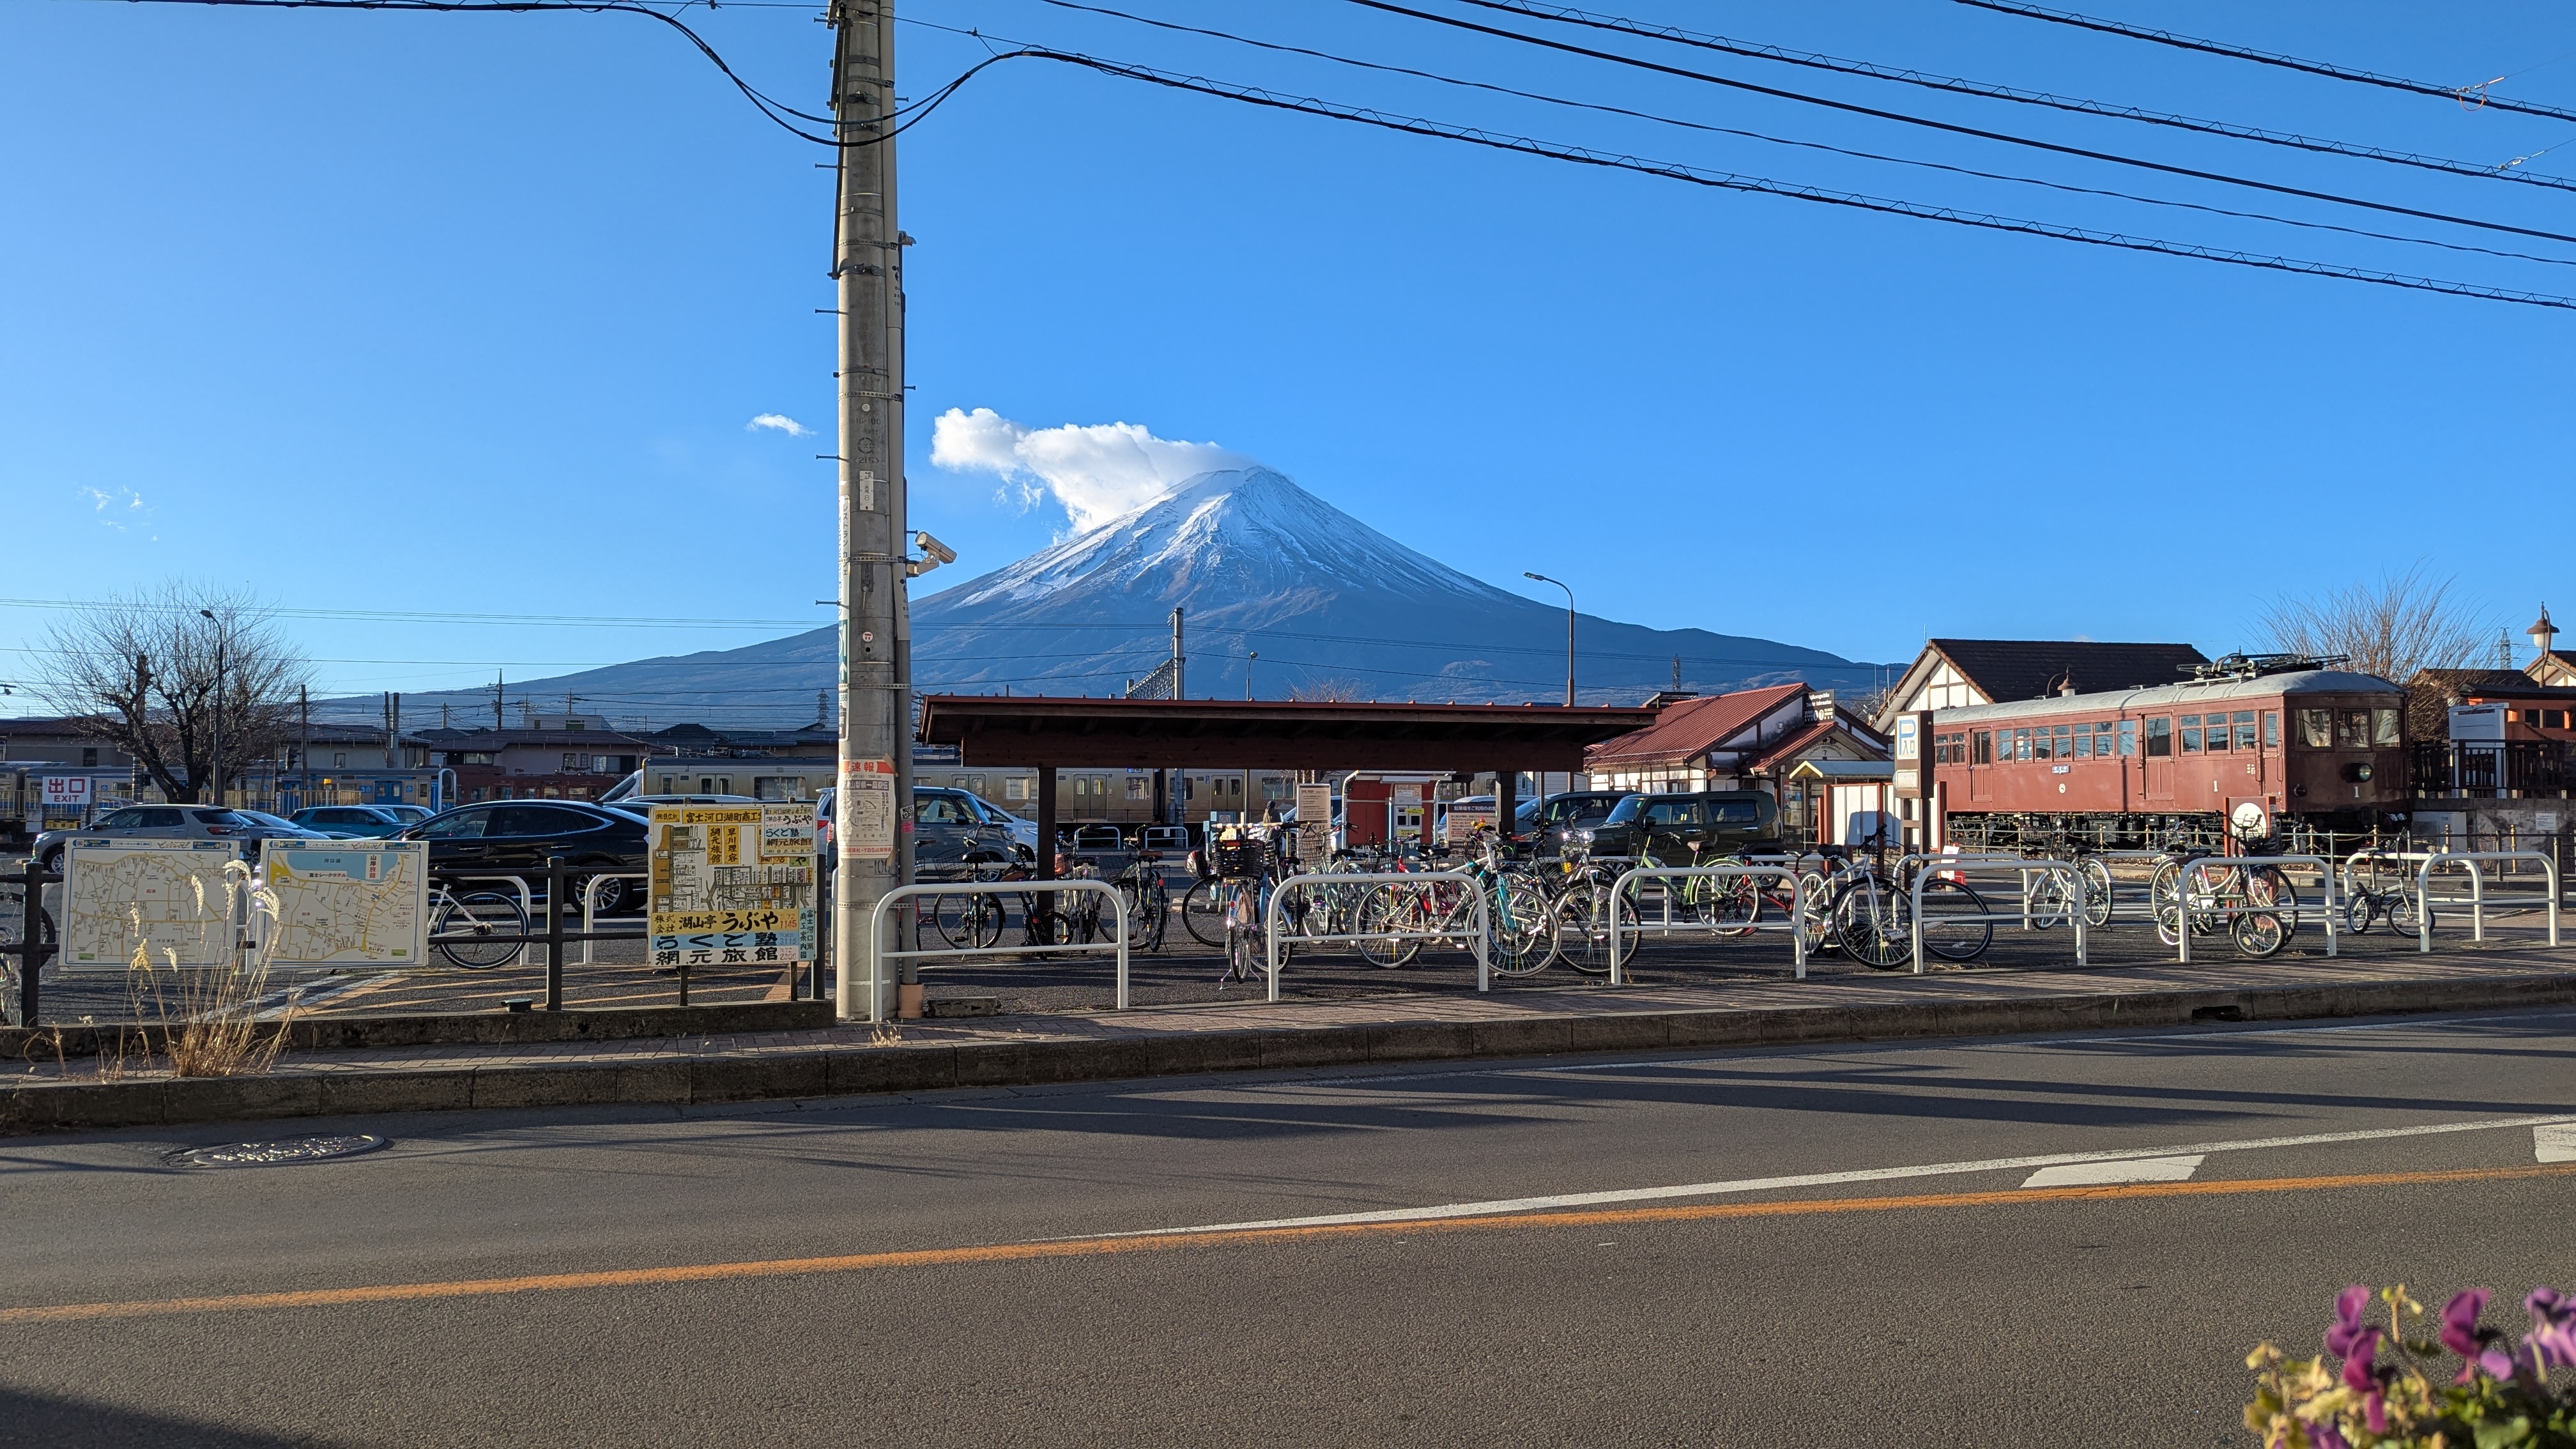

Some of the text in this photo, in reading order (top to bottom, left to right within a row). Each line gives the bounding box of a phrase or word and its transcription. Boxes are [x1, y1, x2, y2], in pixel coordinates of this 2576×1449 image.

[1899, 719, 1916, 755] P
[1903, 740, 1915, 755] 入口
[852, 762, 875, 772] 速報
[48, 778, 85, 793] 出口
[2213, 781, 2218, 792] 1
[2354, 786, 2360, 798] 1
[783, 815, 812, 825] うぶや
[678, 911, 779, 932] 湖山亭 うぶや
[656, 932, 778, 950] らくど塾
[655, 947, 778, 966] 網元旅館
